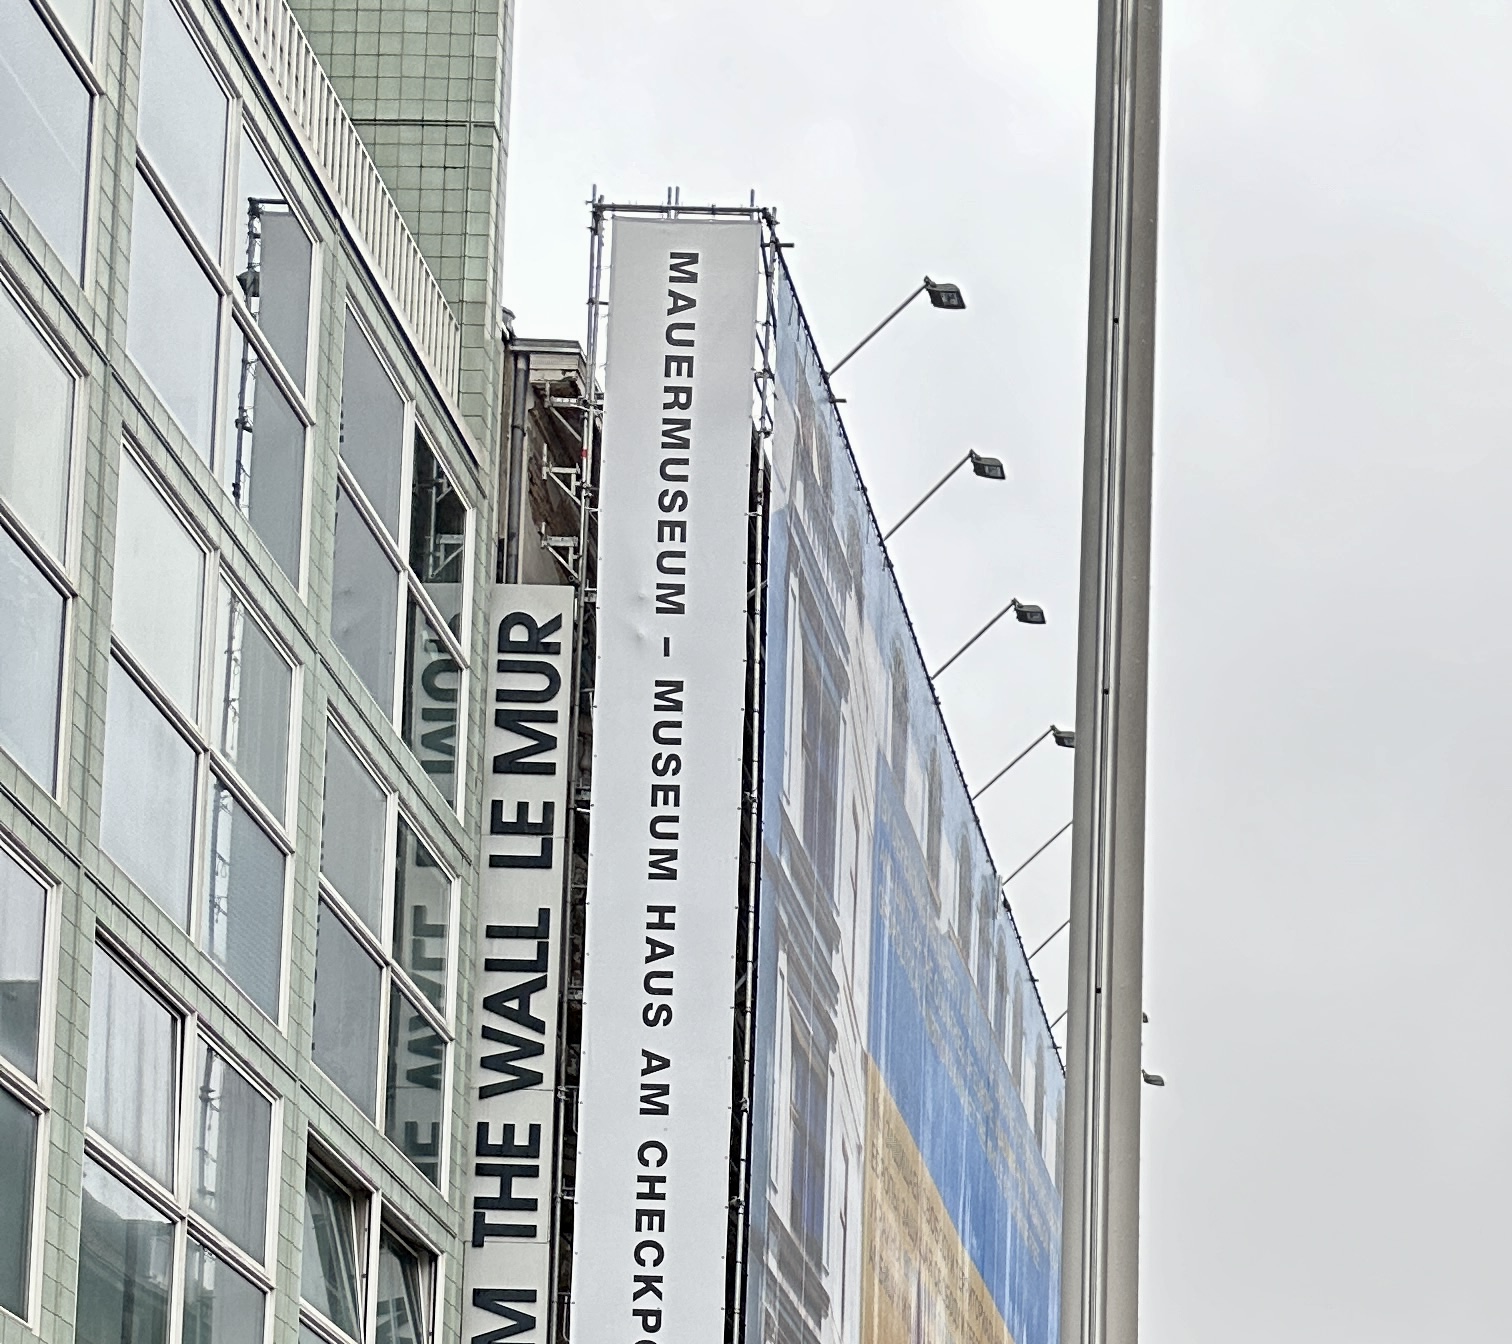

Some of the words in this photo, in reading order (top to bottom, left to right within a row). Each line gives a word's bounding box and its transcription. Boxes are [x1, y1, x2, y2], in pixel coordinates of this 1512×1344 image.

[656, 251, 699, 615] MAUERMUSEUM
[492, 611, 564, 776] MUR
[488, 800, 555, 870] LE
[647, 679, 685, 881] MUSEUM
[478, 907, 551, 1100] WALL
[640, 906, 677, 1028] HAUS
[637, 1048, 671, 1117] AM
[472, 1120, 541, 1248] THE
